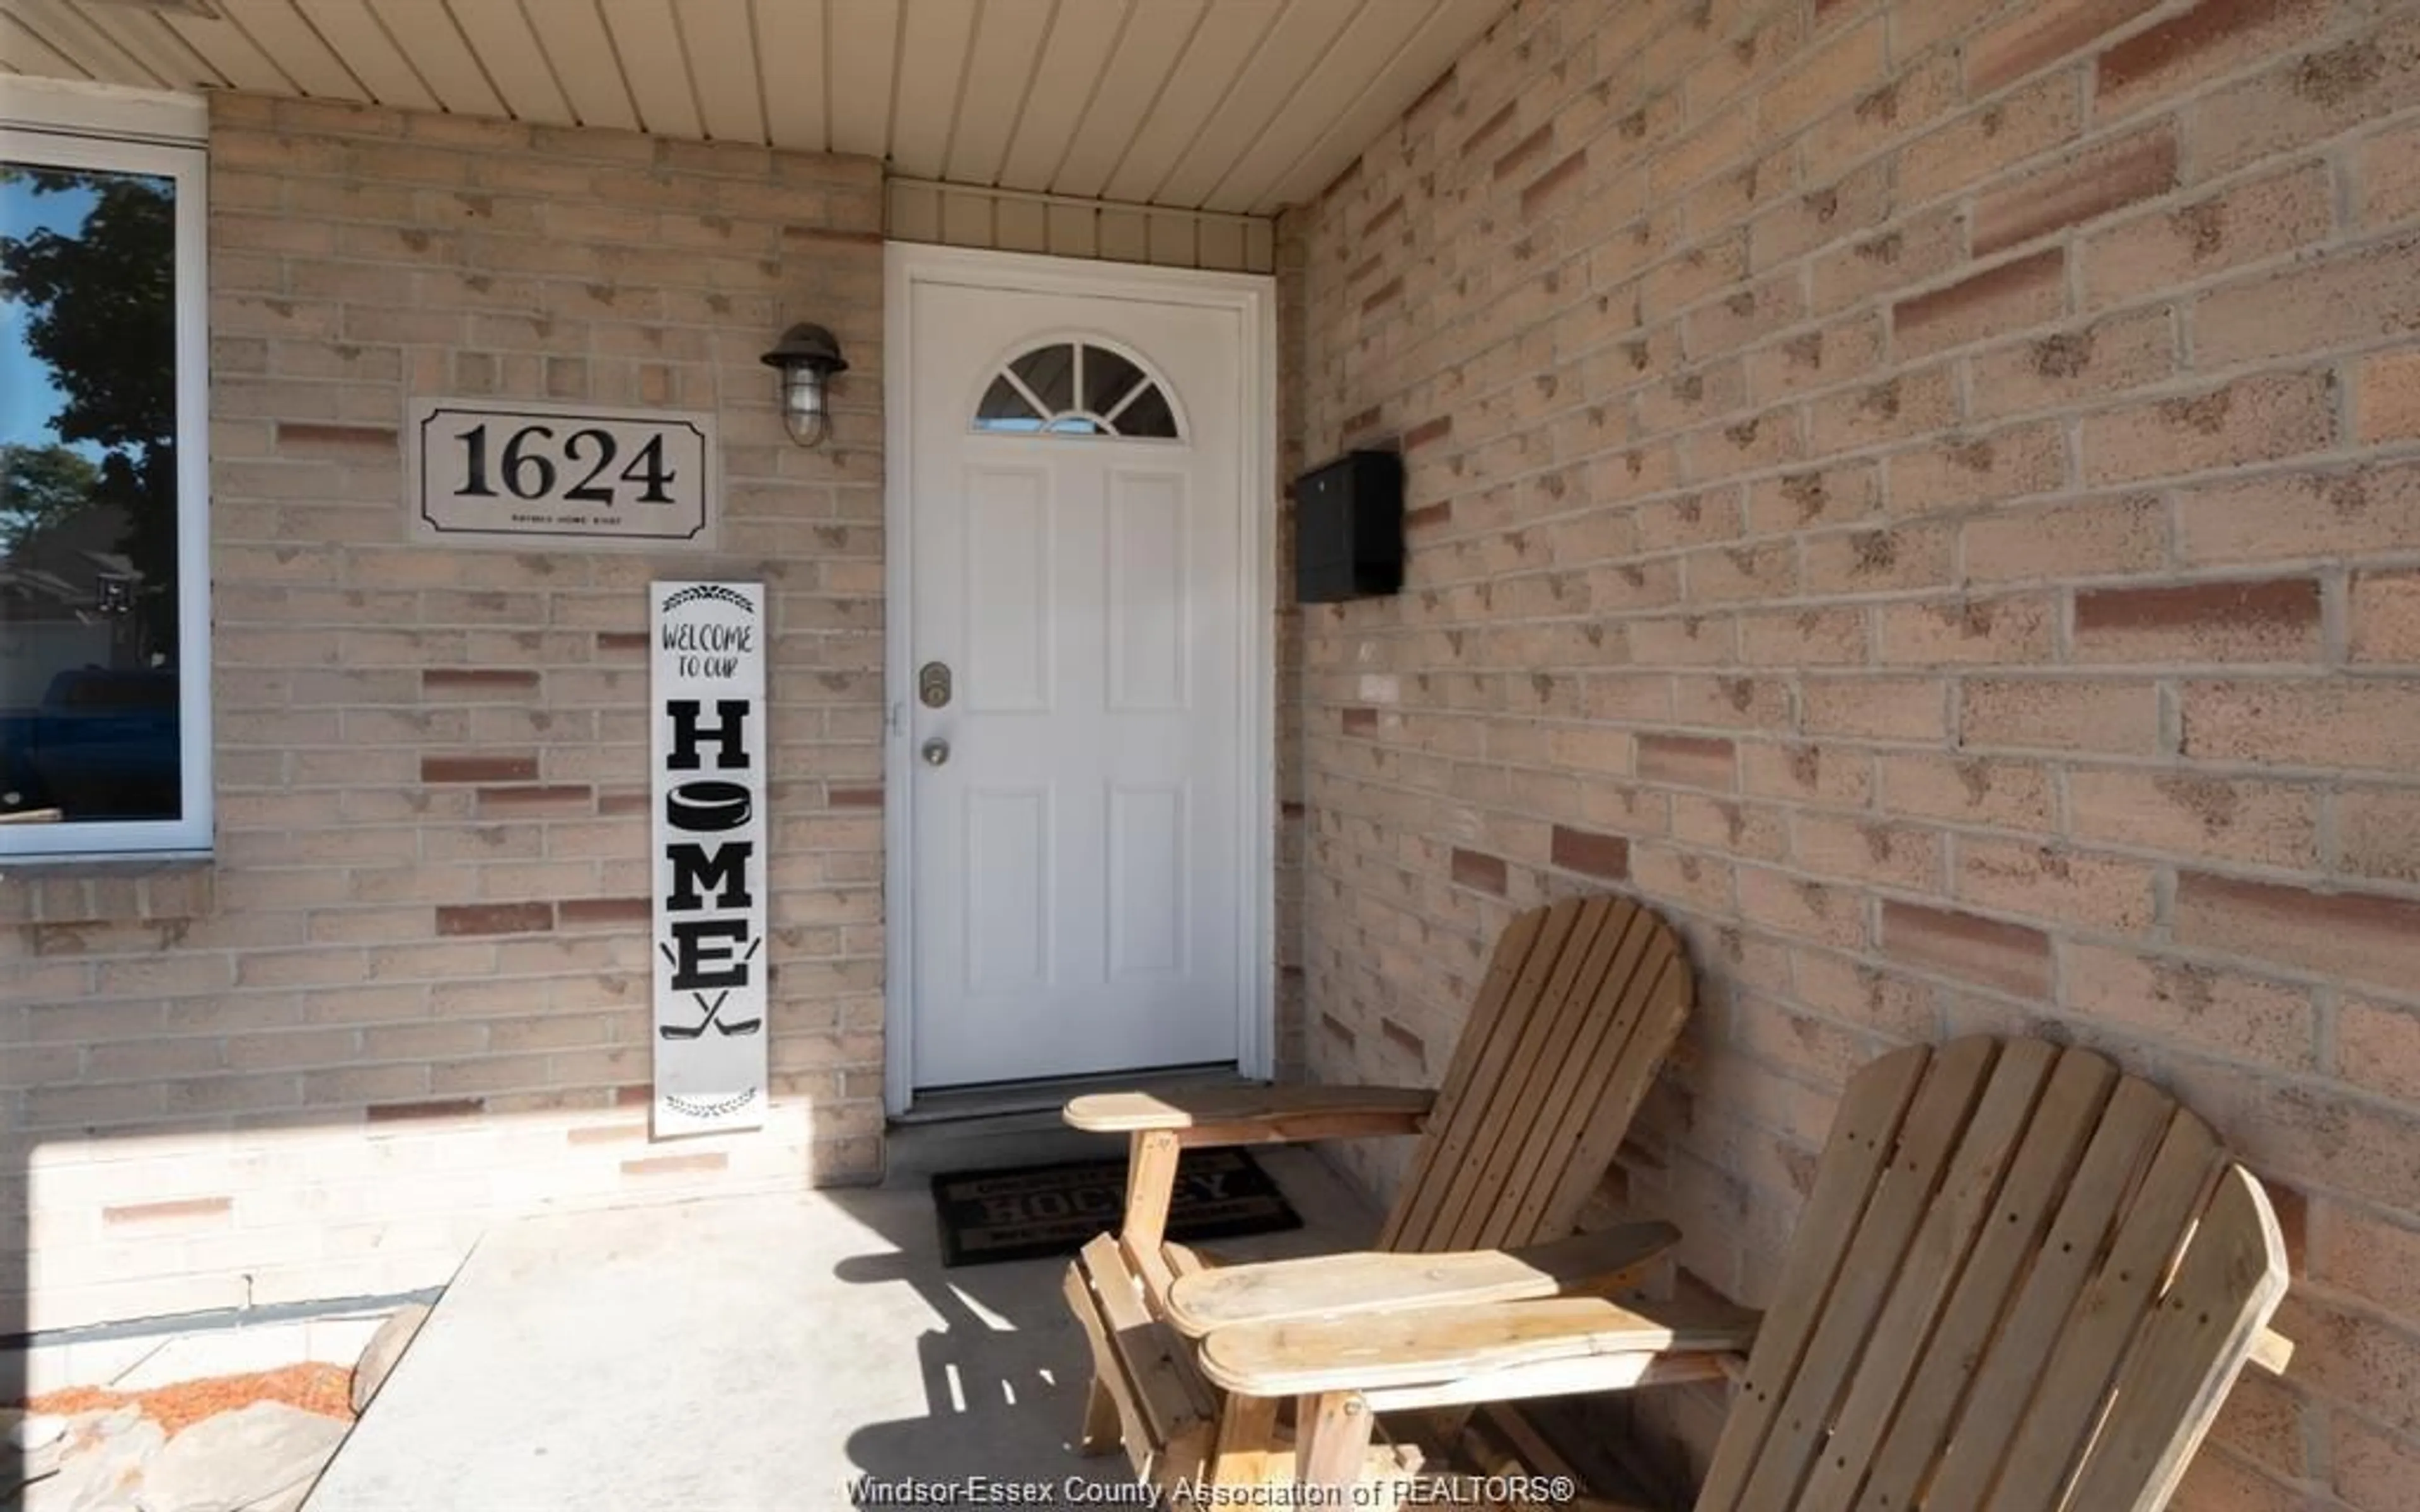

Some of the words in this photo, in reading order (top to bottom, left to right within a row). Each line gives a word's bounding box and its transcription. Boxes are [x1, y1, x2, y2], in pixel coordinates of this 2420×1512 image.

[454, 423, 676, 507] 1624
[662, 623, 753, 653] WELCOME
[679, 655, 700, 678] TO
[704, 655, 739, 679] OUR
